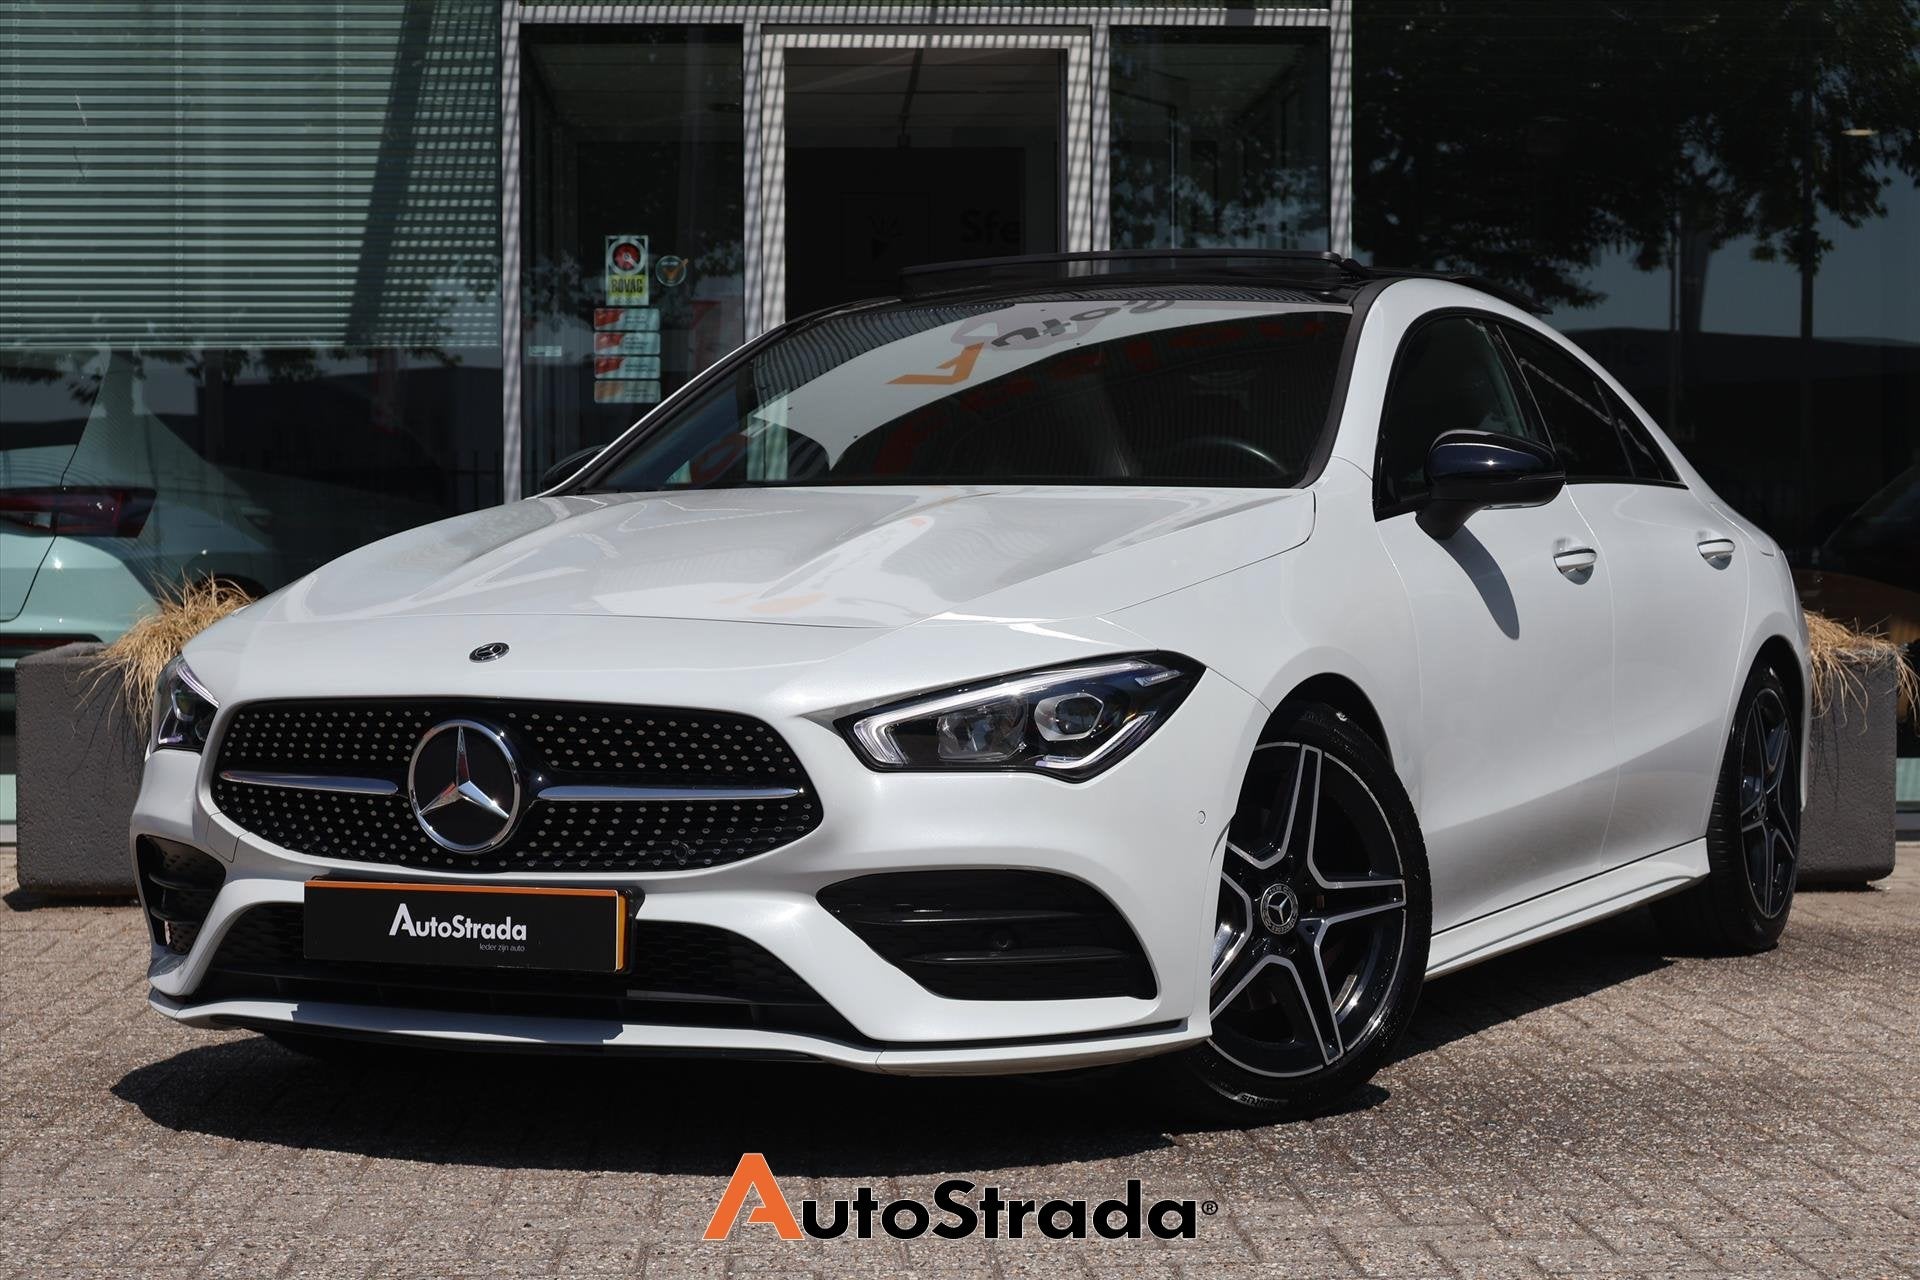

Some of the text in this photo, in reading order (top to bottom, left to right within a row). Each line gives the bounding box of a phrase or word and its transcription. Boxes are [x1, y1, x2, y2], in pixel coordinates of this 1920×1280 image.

[611, 278, 643, 293] BOVAG
[388, 903, 527, 941] AutoStrada
[497, 944, 509, 953] zijn
